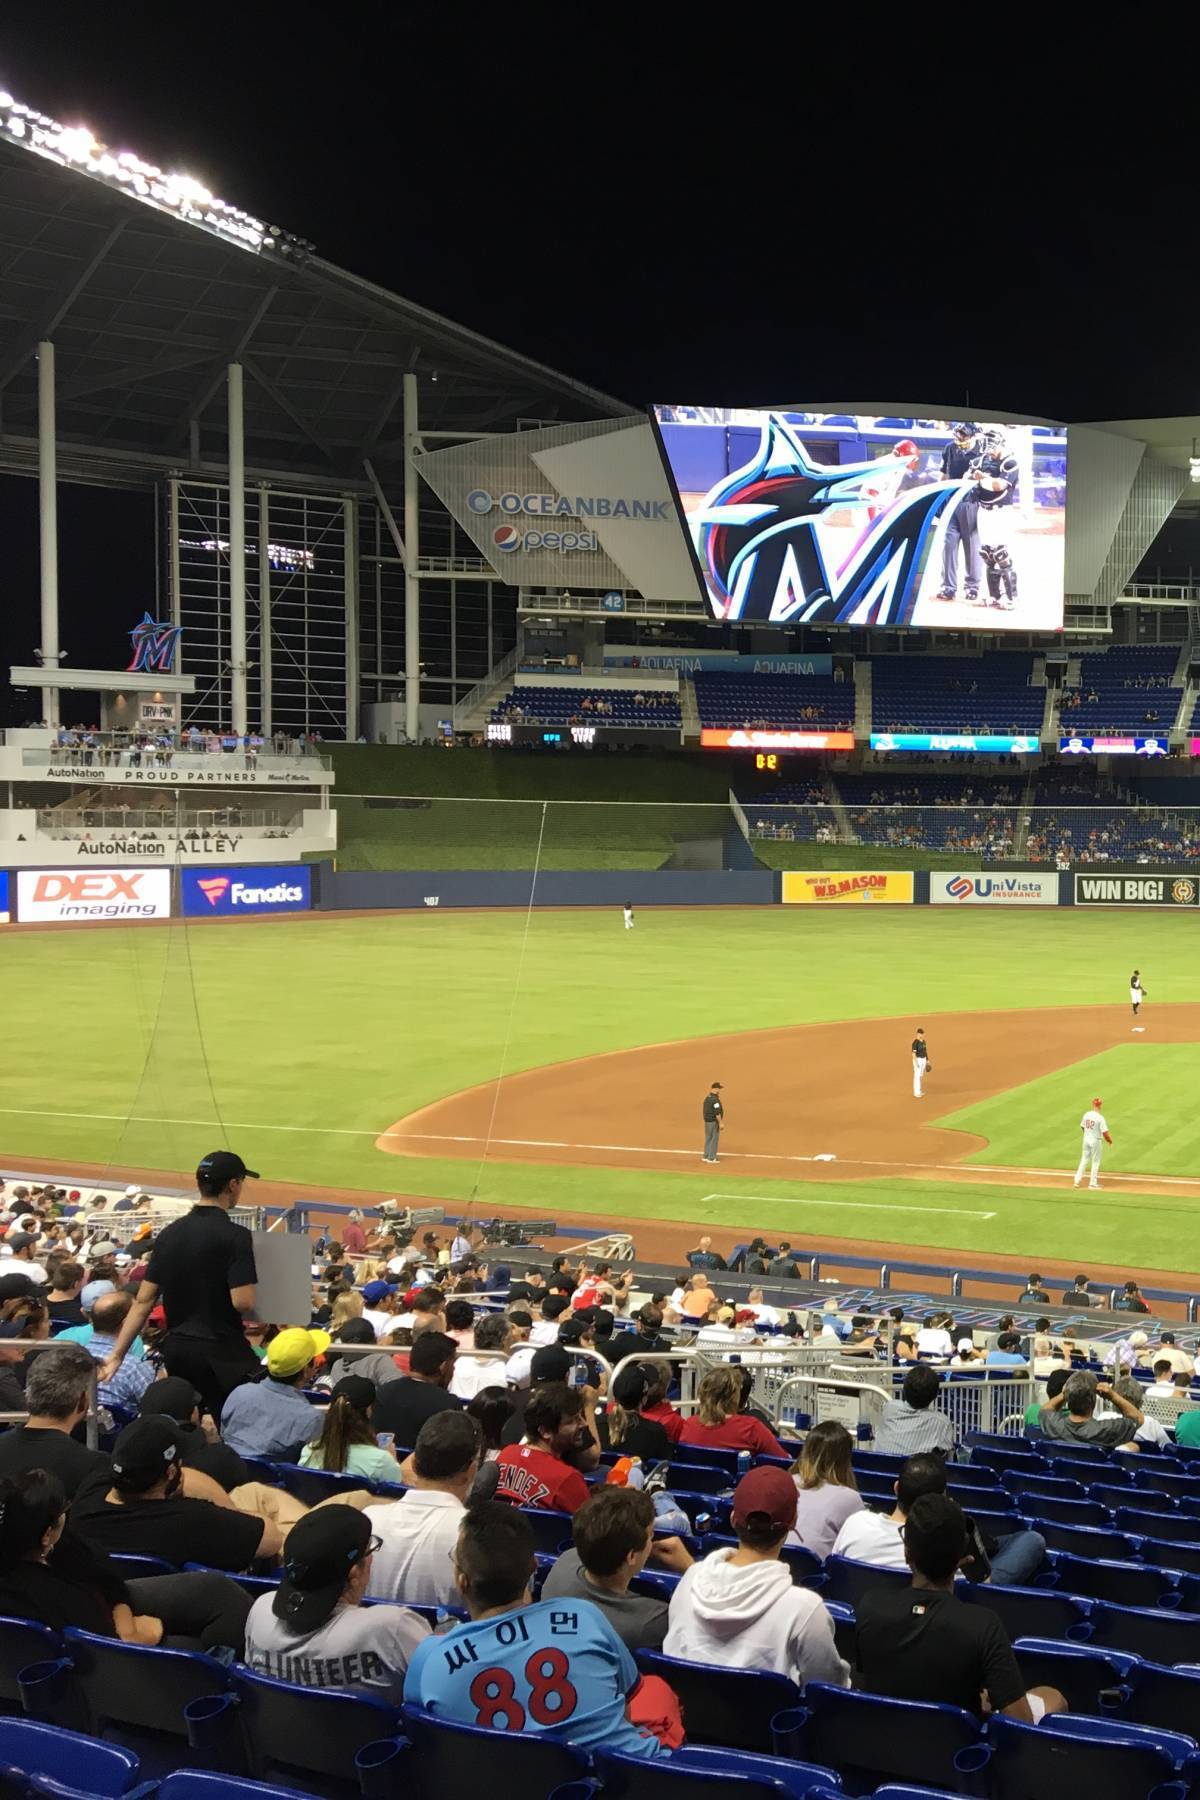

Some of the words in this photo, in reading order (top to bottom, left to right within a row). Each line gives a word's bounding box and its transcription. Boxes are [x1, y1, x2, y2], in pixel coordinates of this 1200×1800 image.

[523, 532, 598, 554] pepsi
[604, 595, 623, 610] 42
[47, 768, 105, 778] AutoNation
[125, 772, 178, 780] PROUD
[187, 773, 257, 781] PARTNERS
[78, 841, 164, 855] AutoNation
[176, 840, 239, 853] ALLEY
[33, 874, 144, 902] DEX
[231, 883, 303, 904] Fanatics
[975, 879, 1041, 897] UniVista
[1082, 880, 1120, 900] WIN
[1124, 881, 1163, 900] BIG!
[60, 904, 156, 915] imaging
[470, 1647, 578, 1731] 88
